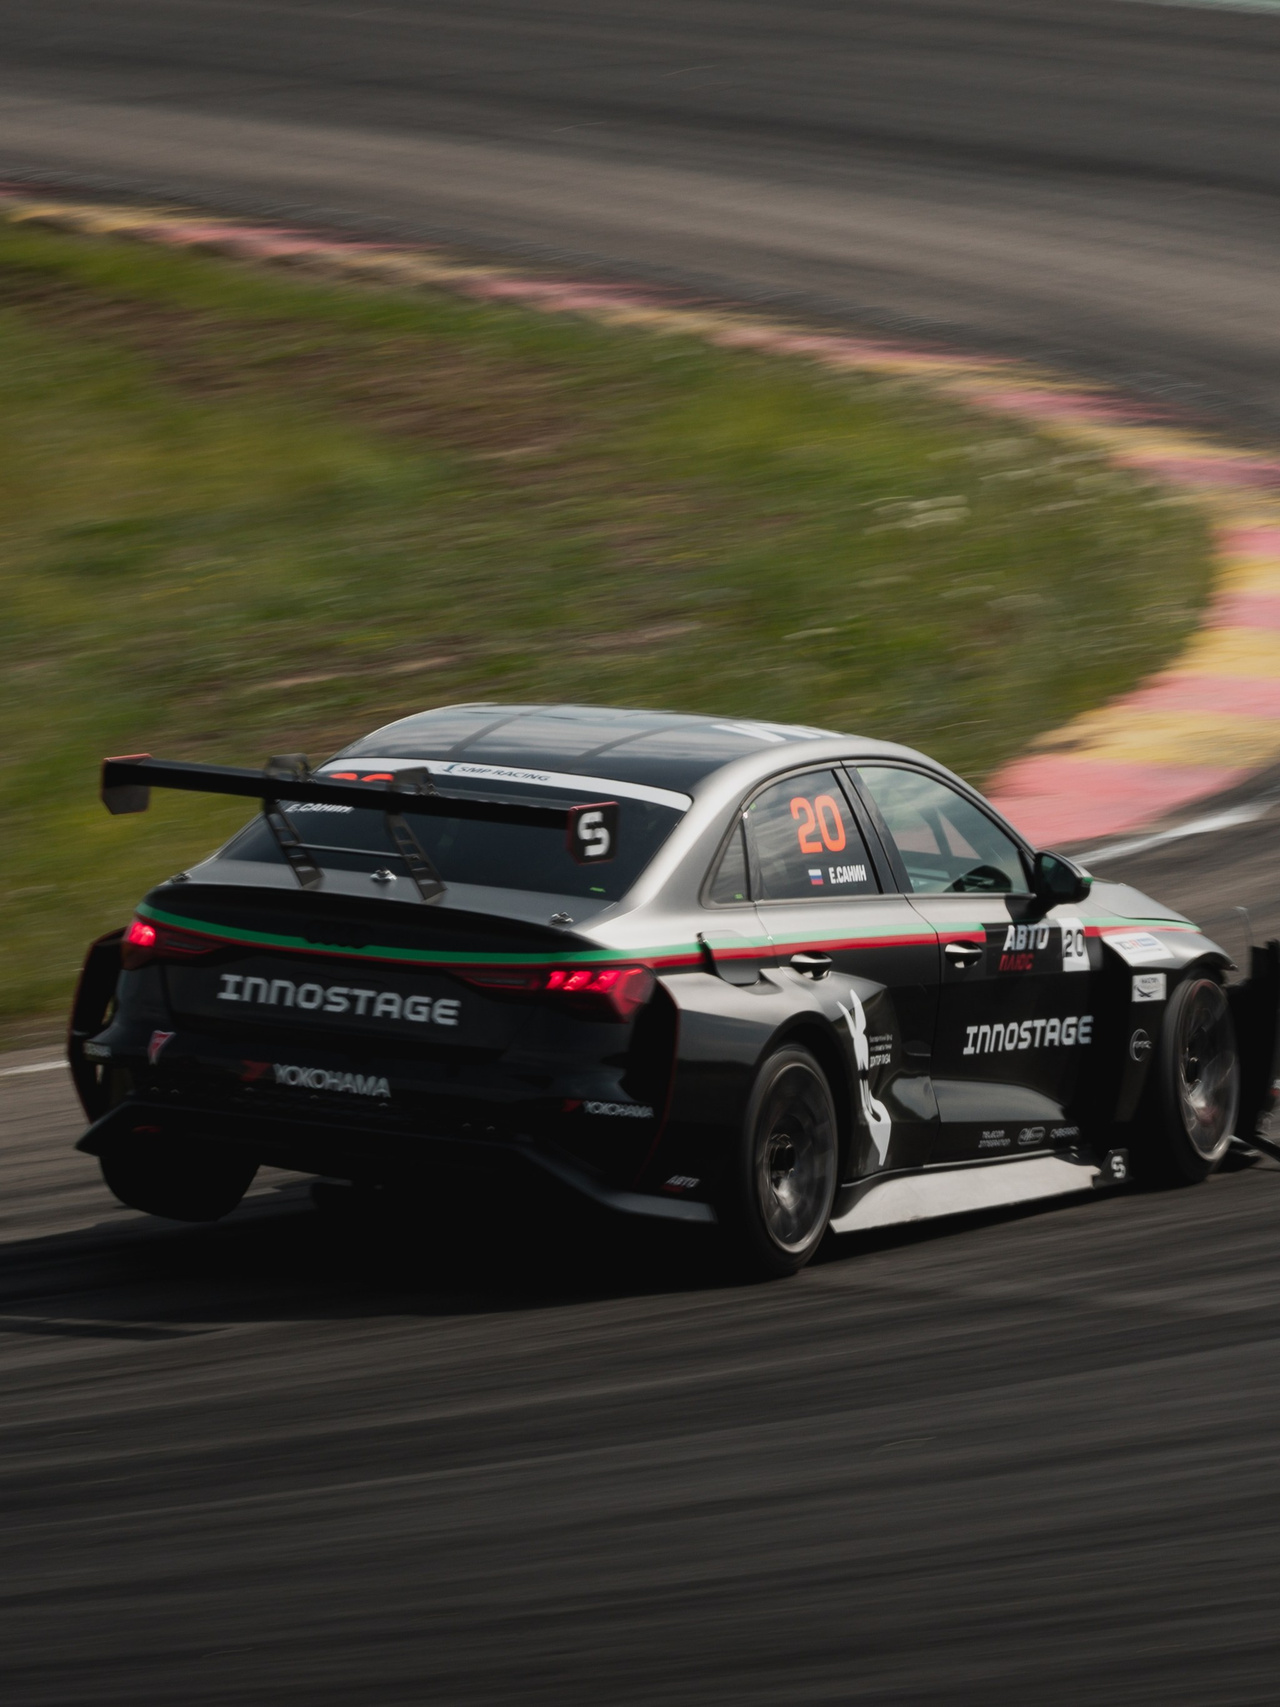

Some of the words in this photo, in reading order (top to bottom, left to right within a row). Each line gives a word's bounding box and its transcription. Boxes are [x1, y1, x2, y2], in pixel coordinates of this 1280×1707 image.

[459, 765, 492, 774] SMP
[493, 769, 551, 782] RACING
[790, 795, 847, 854] 20
[829, 864, 868, 884] Е.САНИН
[1002, 923, 1050, 951] АВТО
[1063, 929, 1085, 958] 20
[216, 973, 462, 1026] INNOSTAGE
[962, 1014, 1095, 1056] INNOSTAGE
[273, 1062, 391, 1099] YOKOHAMA
[583, 1100, 655, 1119] YOKOHAMA
